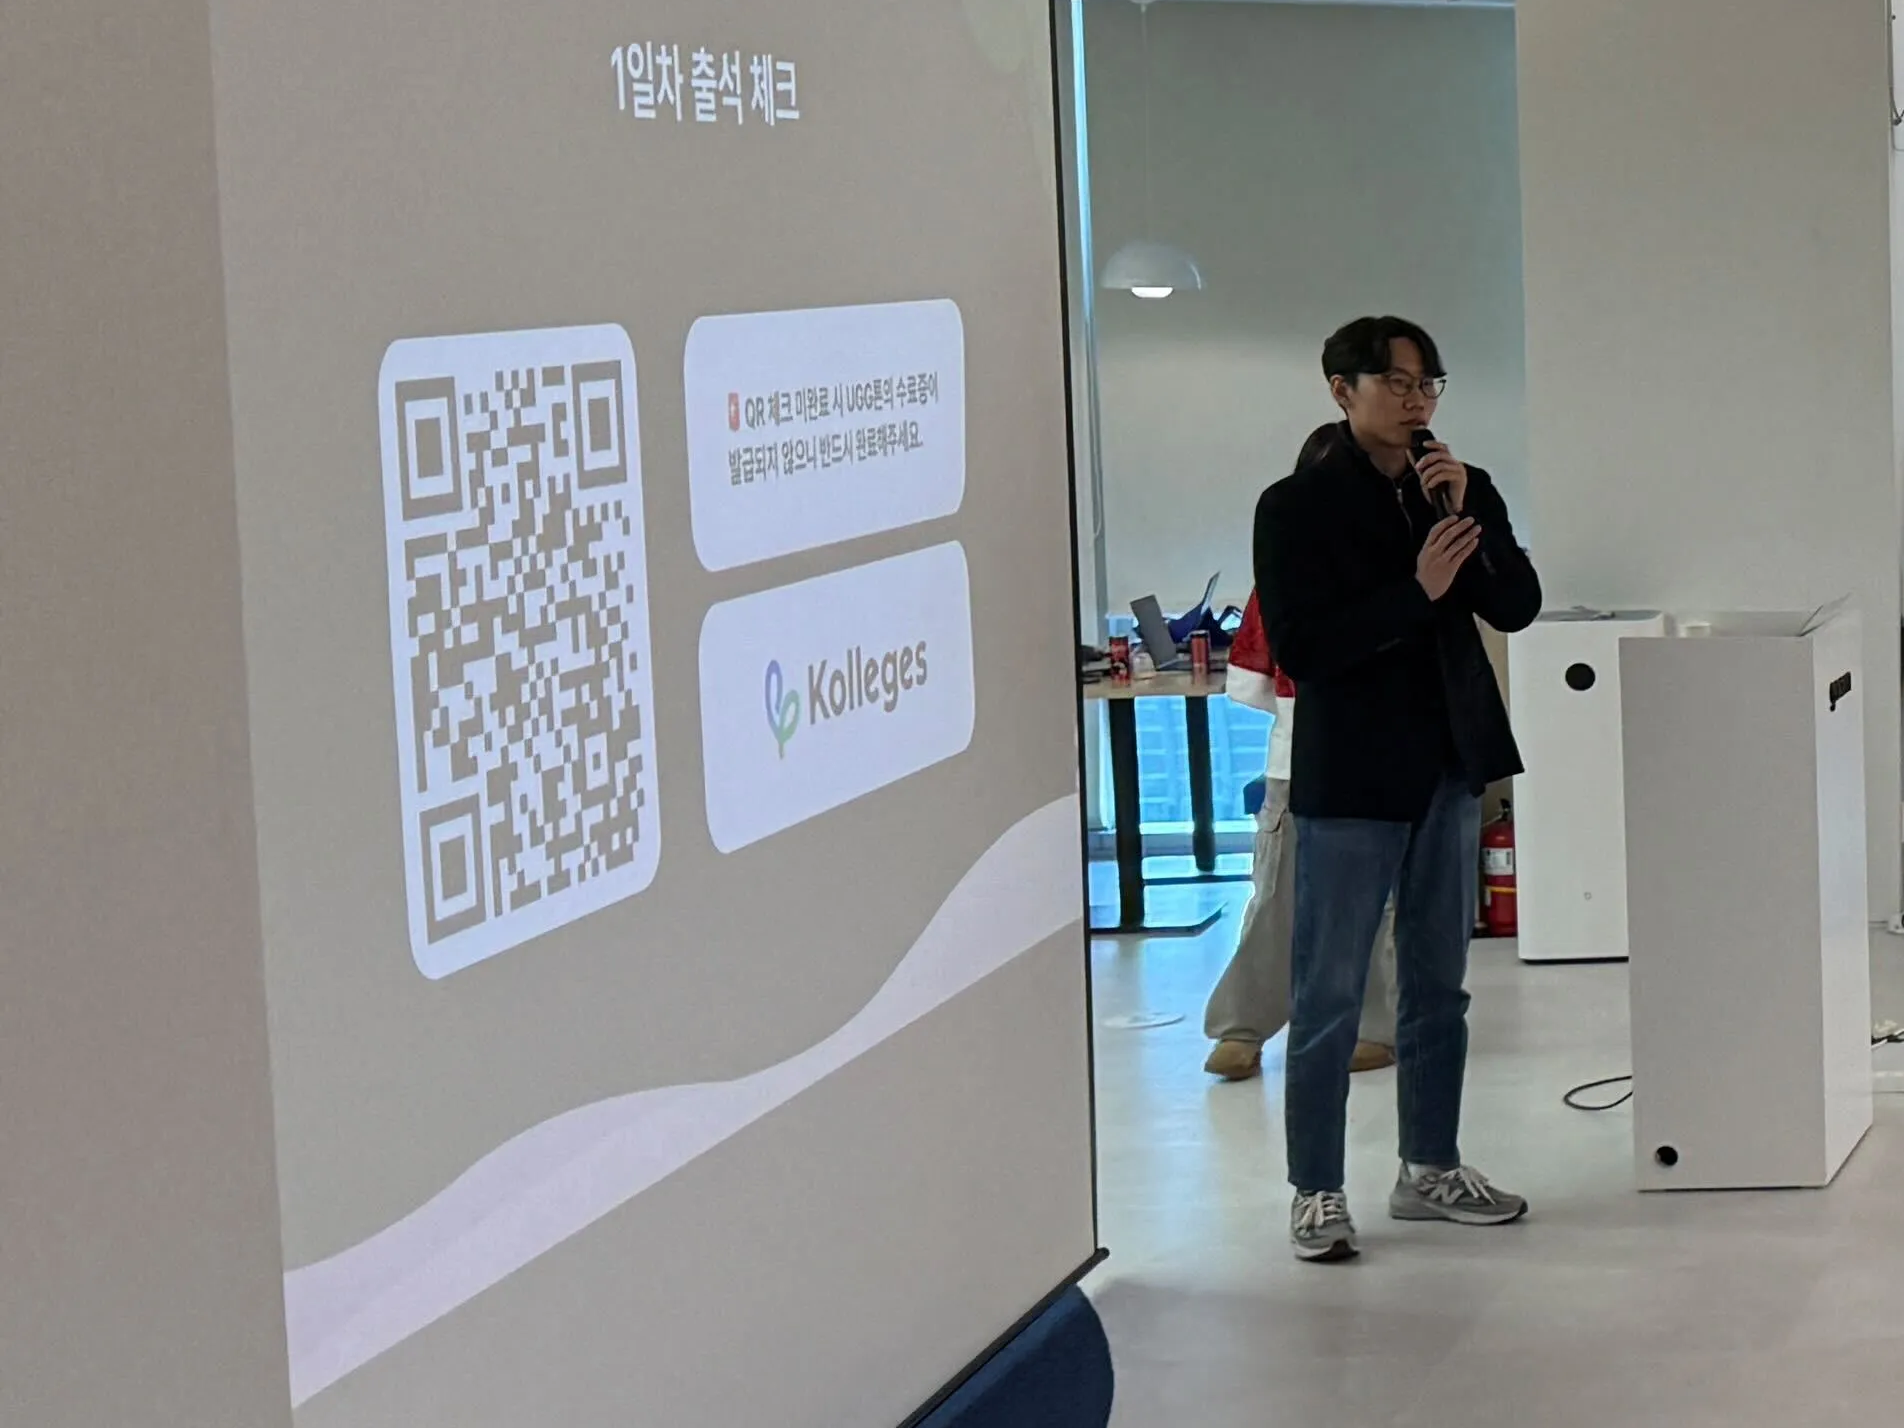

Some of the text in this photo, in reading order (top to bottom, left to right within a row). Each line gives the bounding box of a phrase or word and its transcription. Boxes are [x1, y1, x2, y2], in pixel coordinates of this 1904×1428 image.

[611, 40, 800, 126] 1일차 출석 체크
[744, 397, 766, 429] QR
[768, 391, 793, 426] 체크
[795, 386, 830, 424] 미완료
[832, 382, 844, 418] 시
[728, 441, 779, 486] 발급되지
[781, 434, 816, 475] 않으니
[819, 428, 853, 469] 반드시
[807, 639, 928, 725] Kolleges
